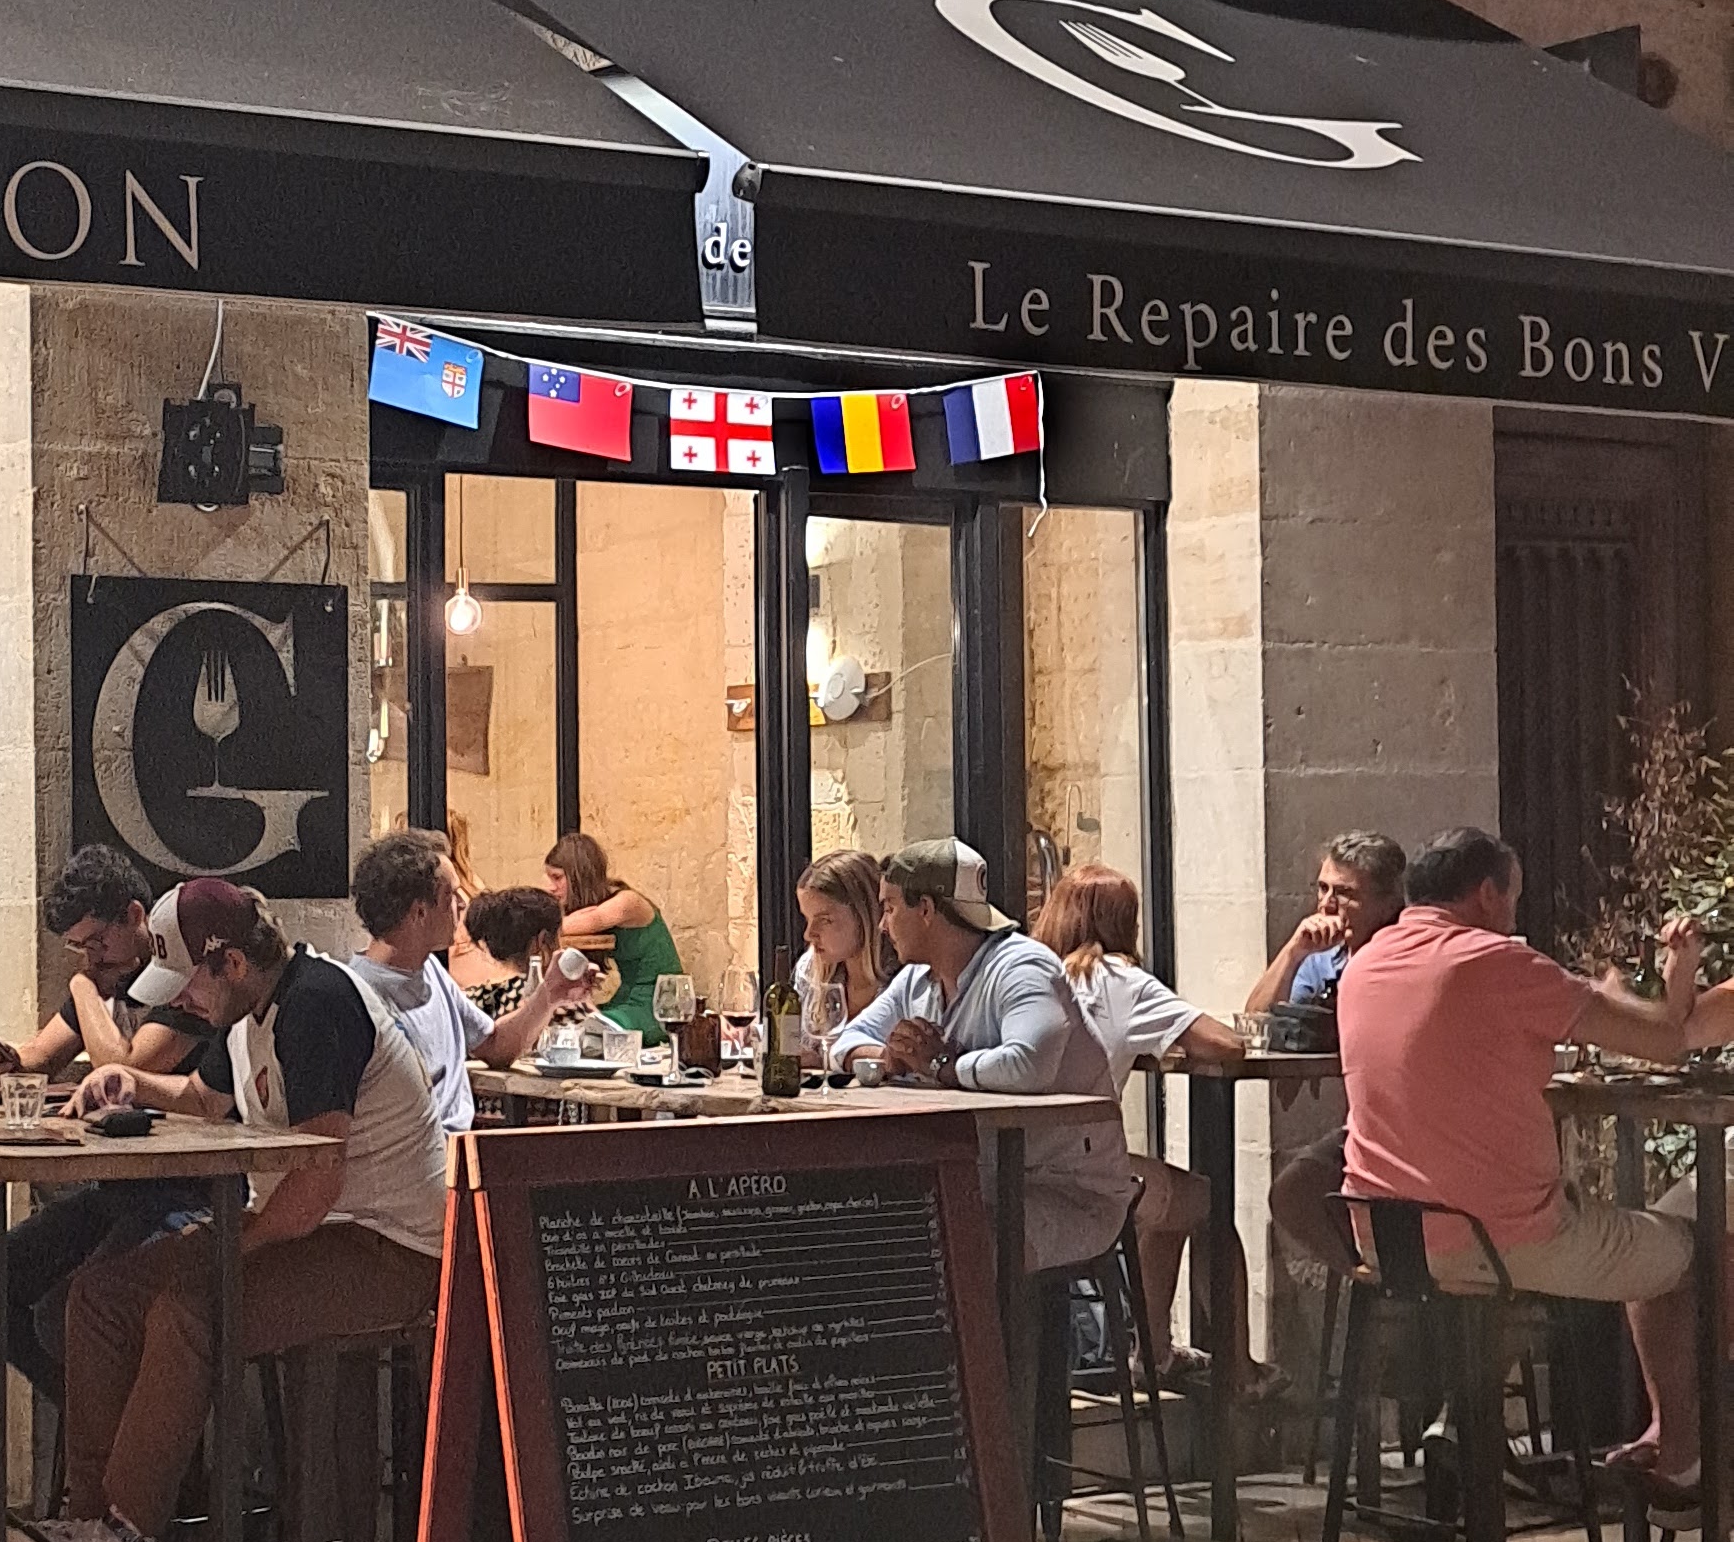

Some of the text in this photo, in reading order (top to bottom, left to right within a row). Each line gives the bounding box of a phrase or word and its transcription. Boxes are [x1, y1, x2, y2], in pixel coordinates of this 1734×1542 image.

[700, 223, 753, 271] de
[969, 261, 1730, 393] Le Repaire des Bons V
[706, 1354, 798, 1378] PETIT PLATS
